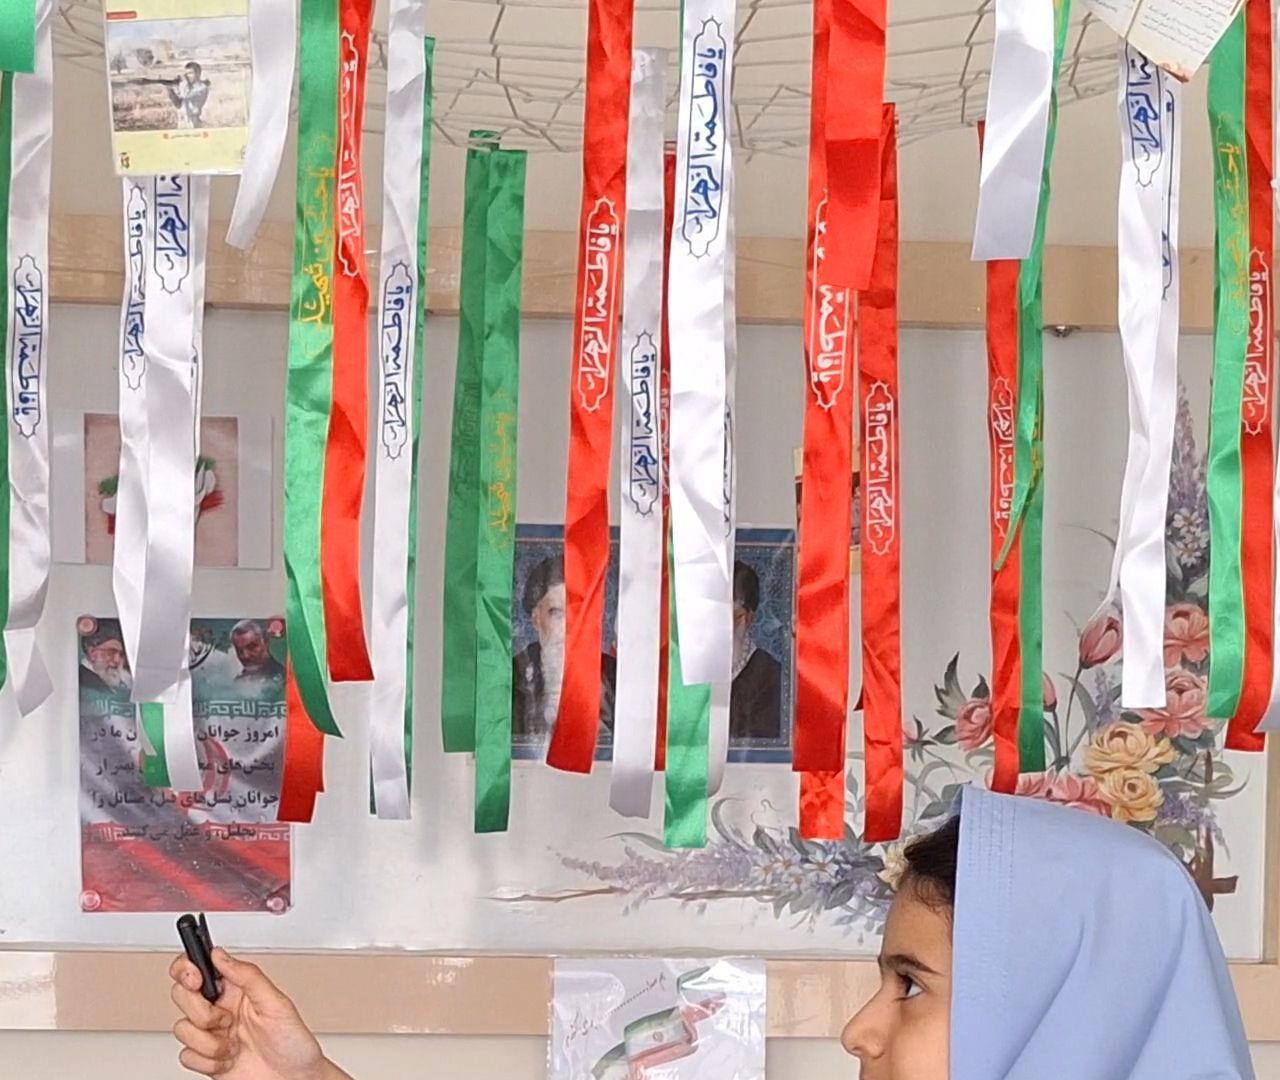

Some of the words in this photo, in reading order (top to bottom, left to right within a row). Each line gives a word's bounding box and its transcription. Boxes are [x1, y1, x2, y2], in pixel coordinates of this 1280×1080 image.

[111, 724, 122, 738] ما
[197, 724, 241, 742] جوانان
[244, 725, 279, 743] امروز
[236, 790, 279, 810] جوانان
